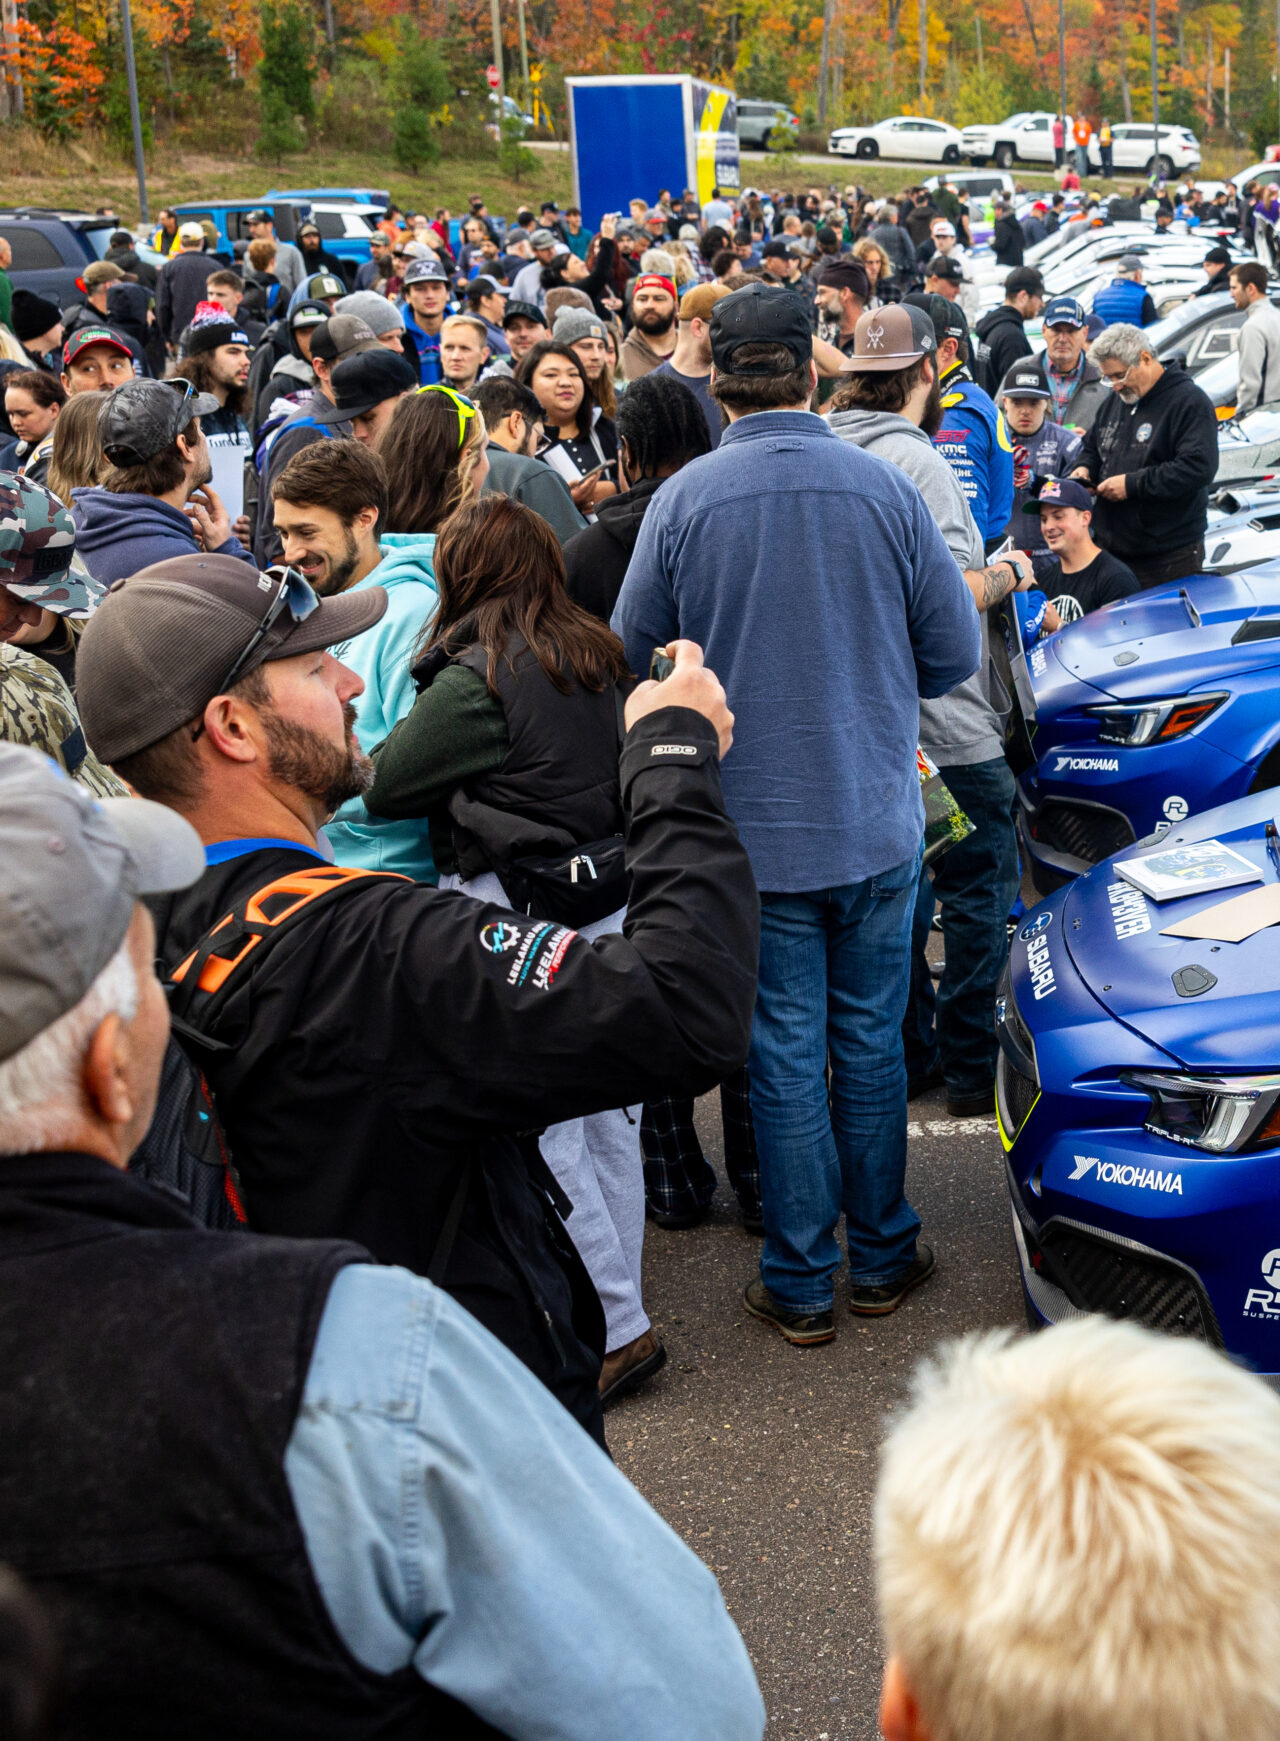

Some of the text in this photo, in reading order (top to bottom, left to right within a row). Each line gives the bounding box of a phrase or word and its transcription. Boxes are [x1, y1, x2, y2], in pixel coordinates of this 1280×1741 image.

[1069, 756, 1119, 771] YOKOHAMA
[1027, 934, 1057, 1000] SUBARU
[1096, 1161, 1183, 1195] YOKOHAMA
